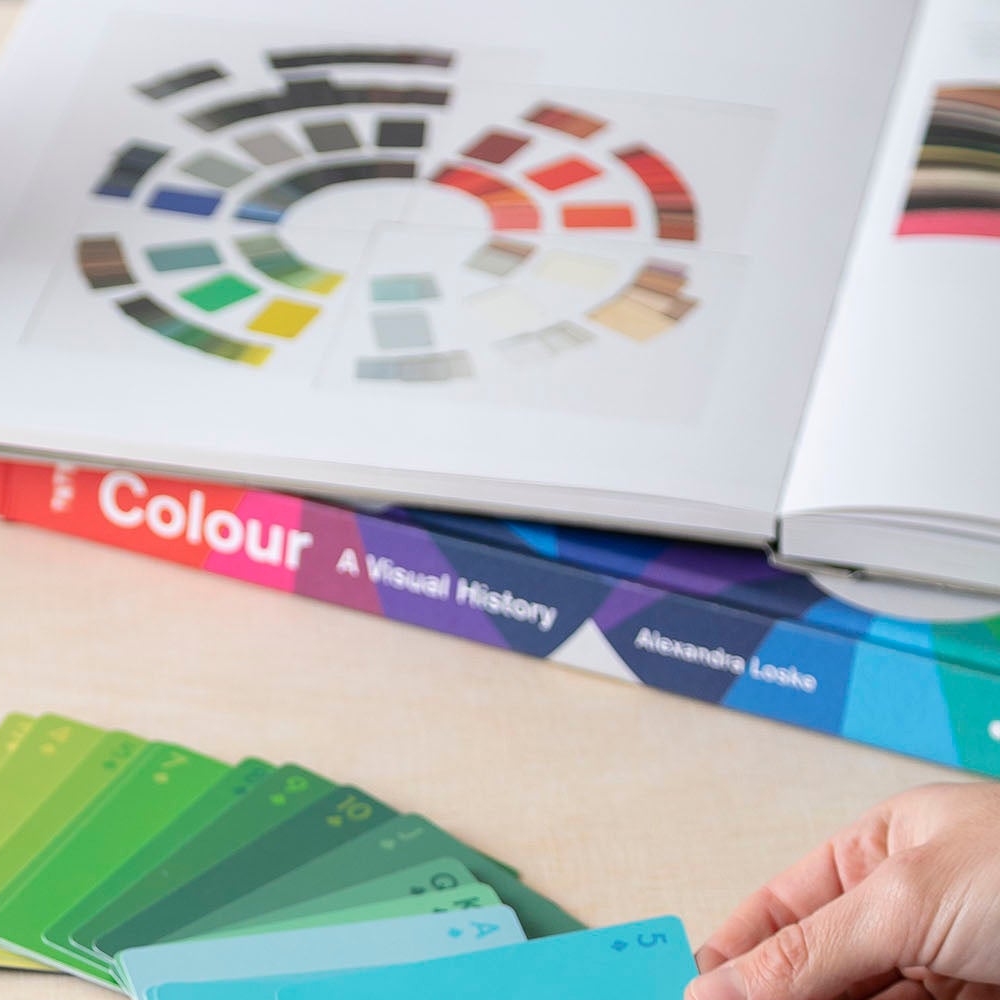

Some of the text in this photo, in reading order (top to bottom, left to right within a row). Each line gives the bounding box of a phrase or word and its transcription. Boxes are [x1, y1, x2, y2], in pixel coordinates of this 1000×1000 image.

[98, 469, 314, 571] Colour
[336, 547, 360, 577] A
[365, 553, 450, 600] Visual
[455, 577, 557, 632] History
[634, 626, 745, 675] Alexandra
[161, 752, 188, 768] 7
[336, 795, 372, 821] 10
[430, 872, 458, 891] Q
[453, 897, 481, 911] K
[470, 920, 499, 938] A
[637, 933, 667, 948] 5
